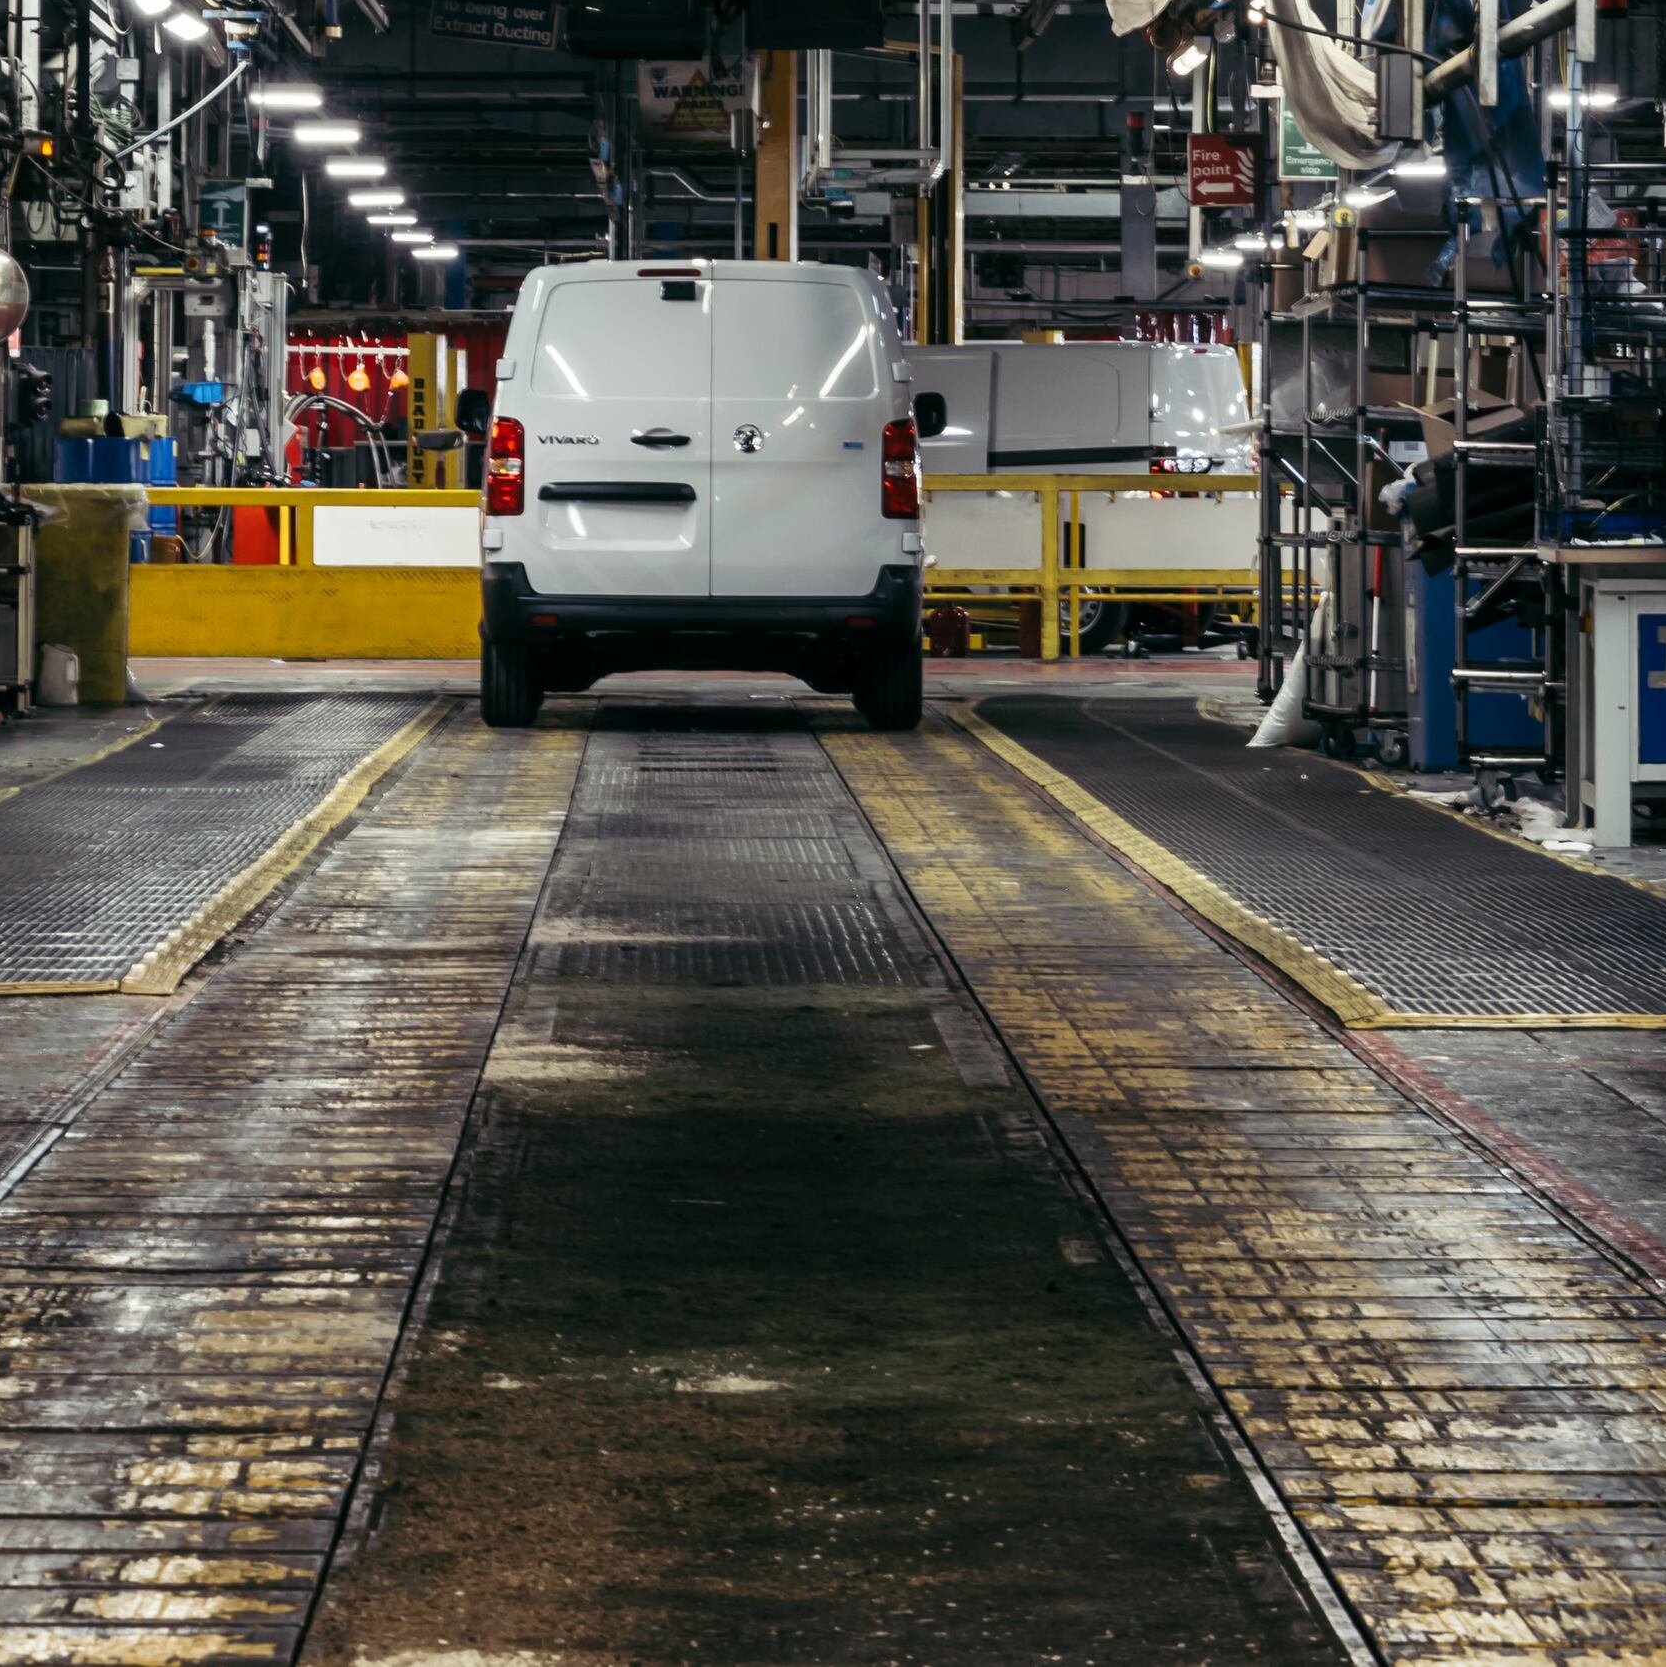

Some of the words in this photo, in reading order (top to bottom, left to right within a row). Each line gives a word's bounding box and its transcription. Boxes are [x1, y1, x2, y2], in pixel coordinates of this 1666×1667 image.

[465, 1, 508, 20] being
[513, 6, 547, 21] over
[434, 15, 488, 35] Extract
[493, 22, 552, 45] Ducting
[1193, 149, 1221, 161] Fire
[1285, 155, 1335, 167] Emergency
[1193, 164, 1231, 178] point
[1300, 167, 1321, 175] stop
[412, 378, 425, 483] BRADURY
[536, 435, 599, 444] VIVARO
